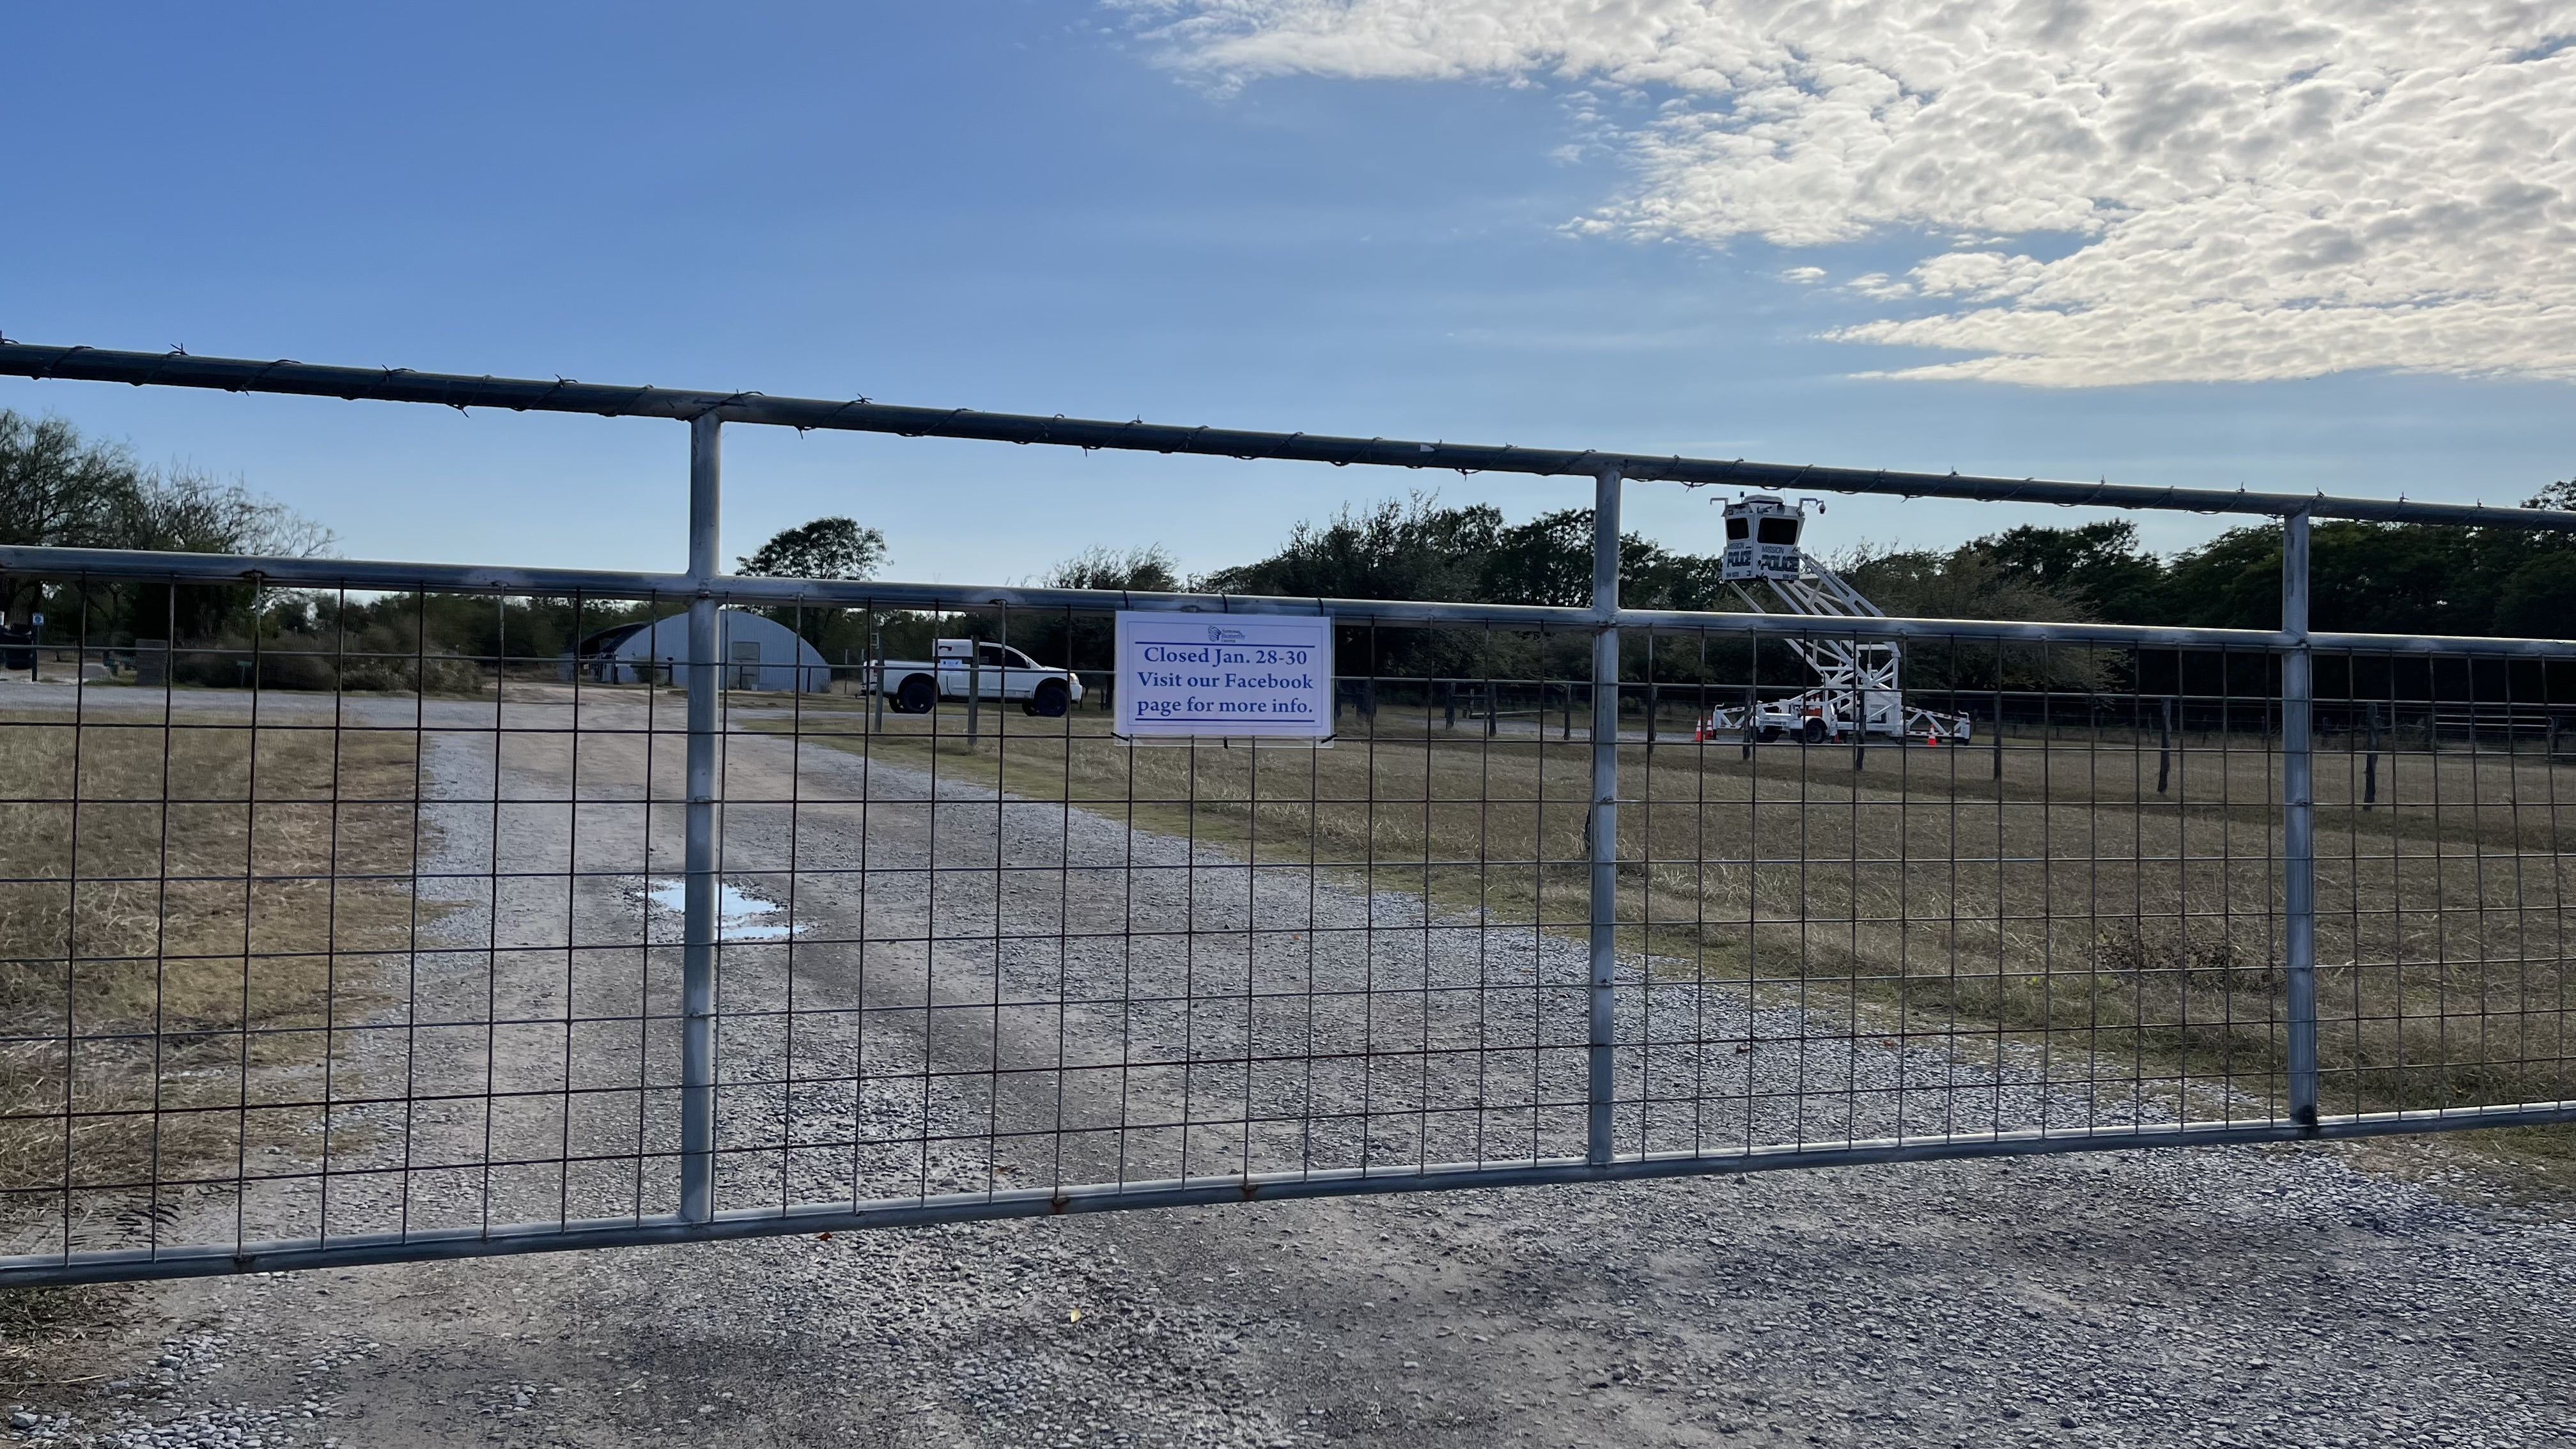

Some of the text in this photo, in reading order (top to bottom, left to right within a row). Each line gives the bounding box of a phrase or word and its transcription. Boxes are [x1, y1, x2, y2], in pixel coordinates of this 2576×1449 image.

[1727, 550, 1751, 568] POLICE
[1760, 555, 1799, 572] POLICE
[1144, 647, 1307, 667] Closed Jan. 28-30
[1137, 672, 1314, 689] Visit our Facebook
[1137, 697, 1313, 717] page for more info.
